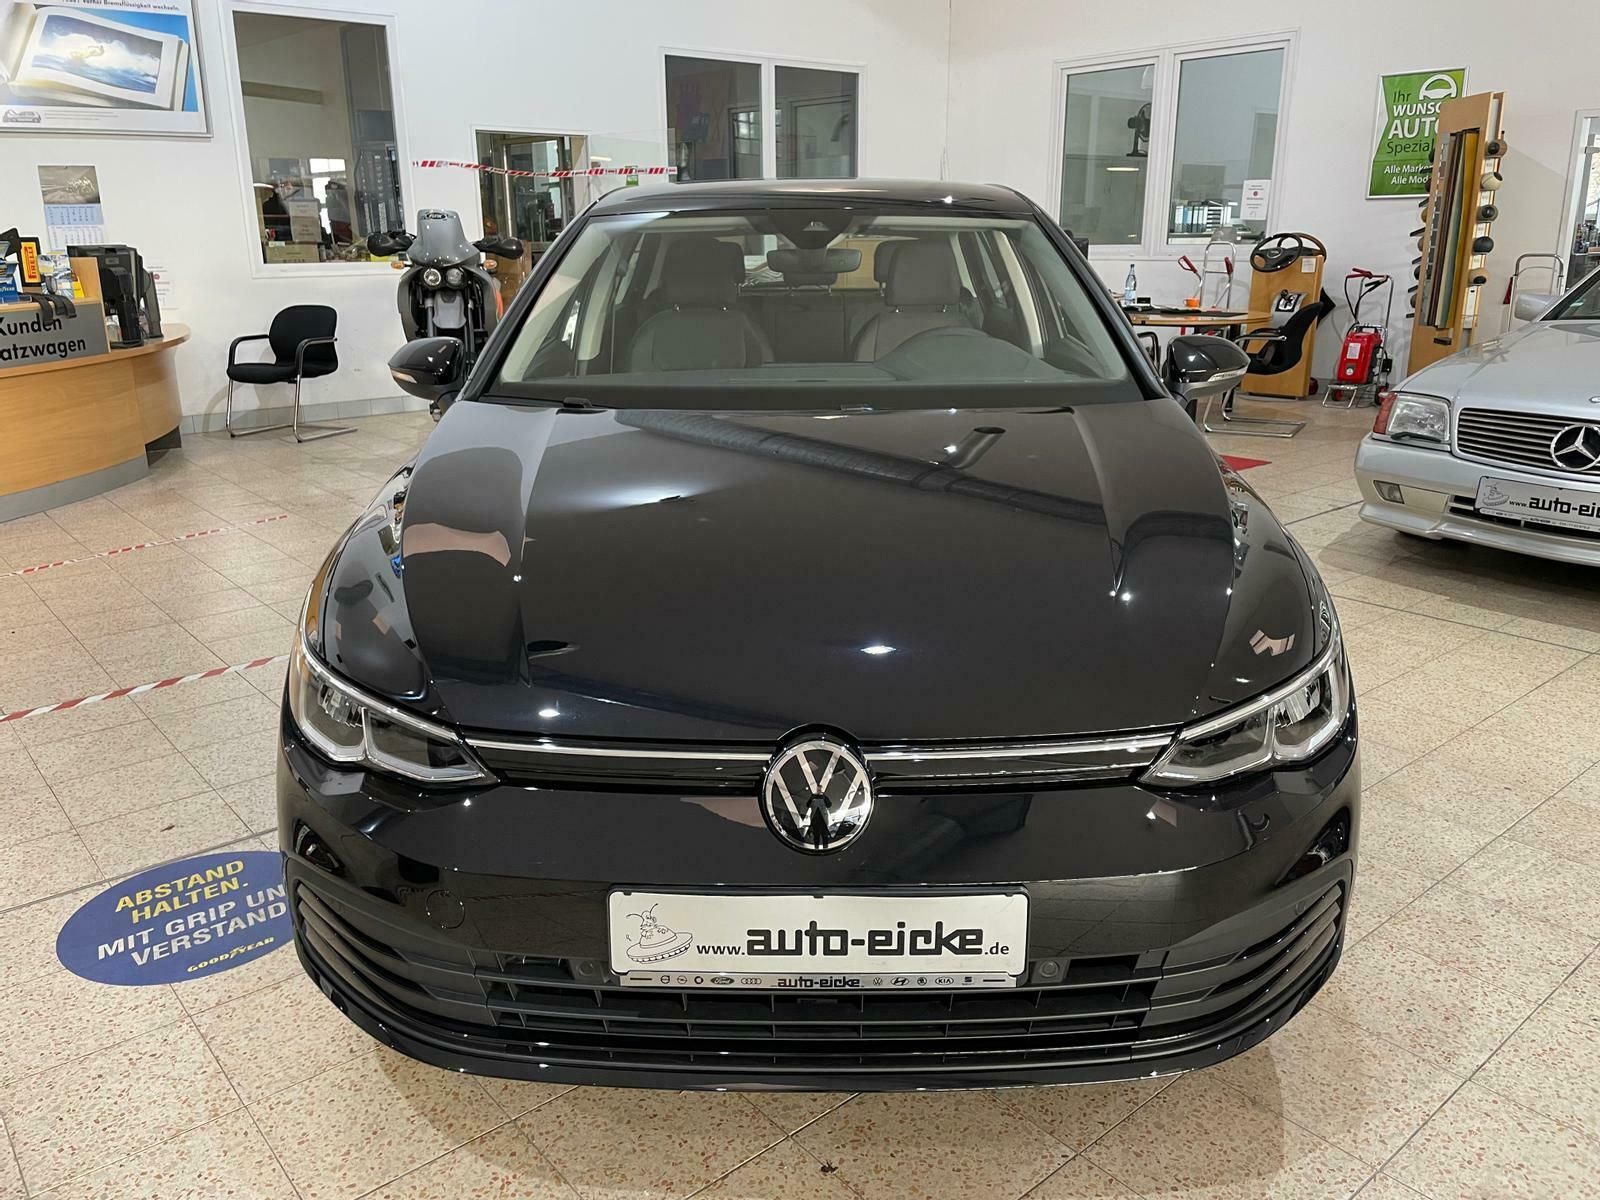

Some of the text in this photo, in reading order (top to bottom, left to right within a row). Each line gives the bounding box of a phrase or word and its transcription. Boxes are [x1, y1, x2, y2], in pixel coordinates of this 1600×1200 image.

[1393, 90, 1411, 103] Ihr
[1384, 164, 1401, 174] Alle
[1391, 175, 1407, 185] Alle
[23, 246, 37, 279] PIRELLI
[0, 339, 86, 361] atzwagen
[115, 860, 244, 912] ABSTAND
[98, 928, 154, 960] MIT
[165, 901, 236, 936] GRIP
[131, 902, 287, 967] VERSTAND
[696, 920, 1010, 956] www.auto-eicke.de
[187, 936, 275, 973] GOODYEAR
[777, 976, 860, 988] auto-eicke
